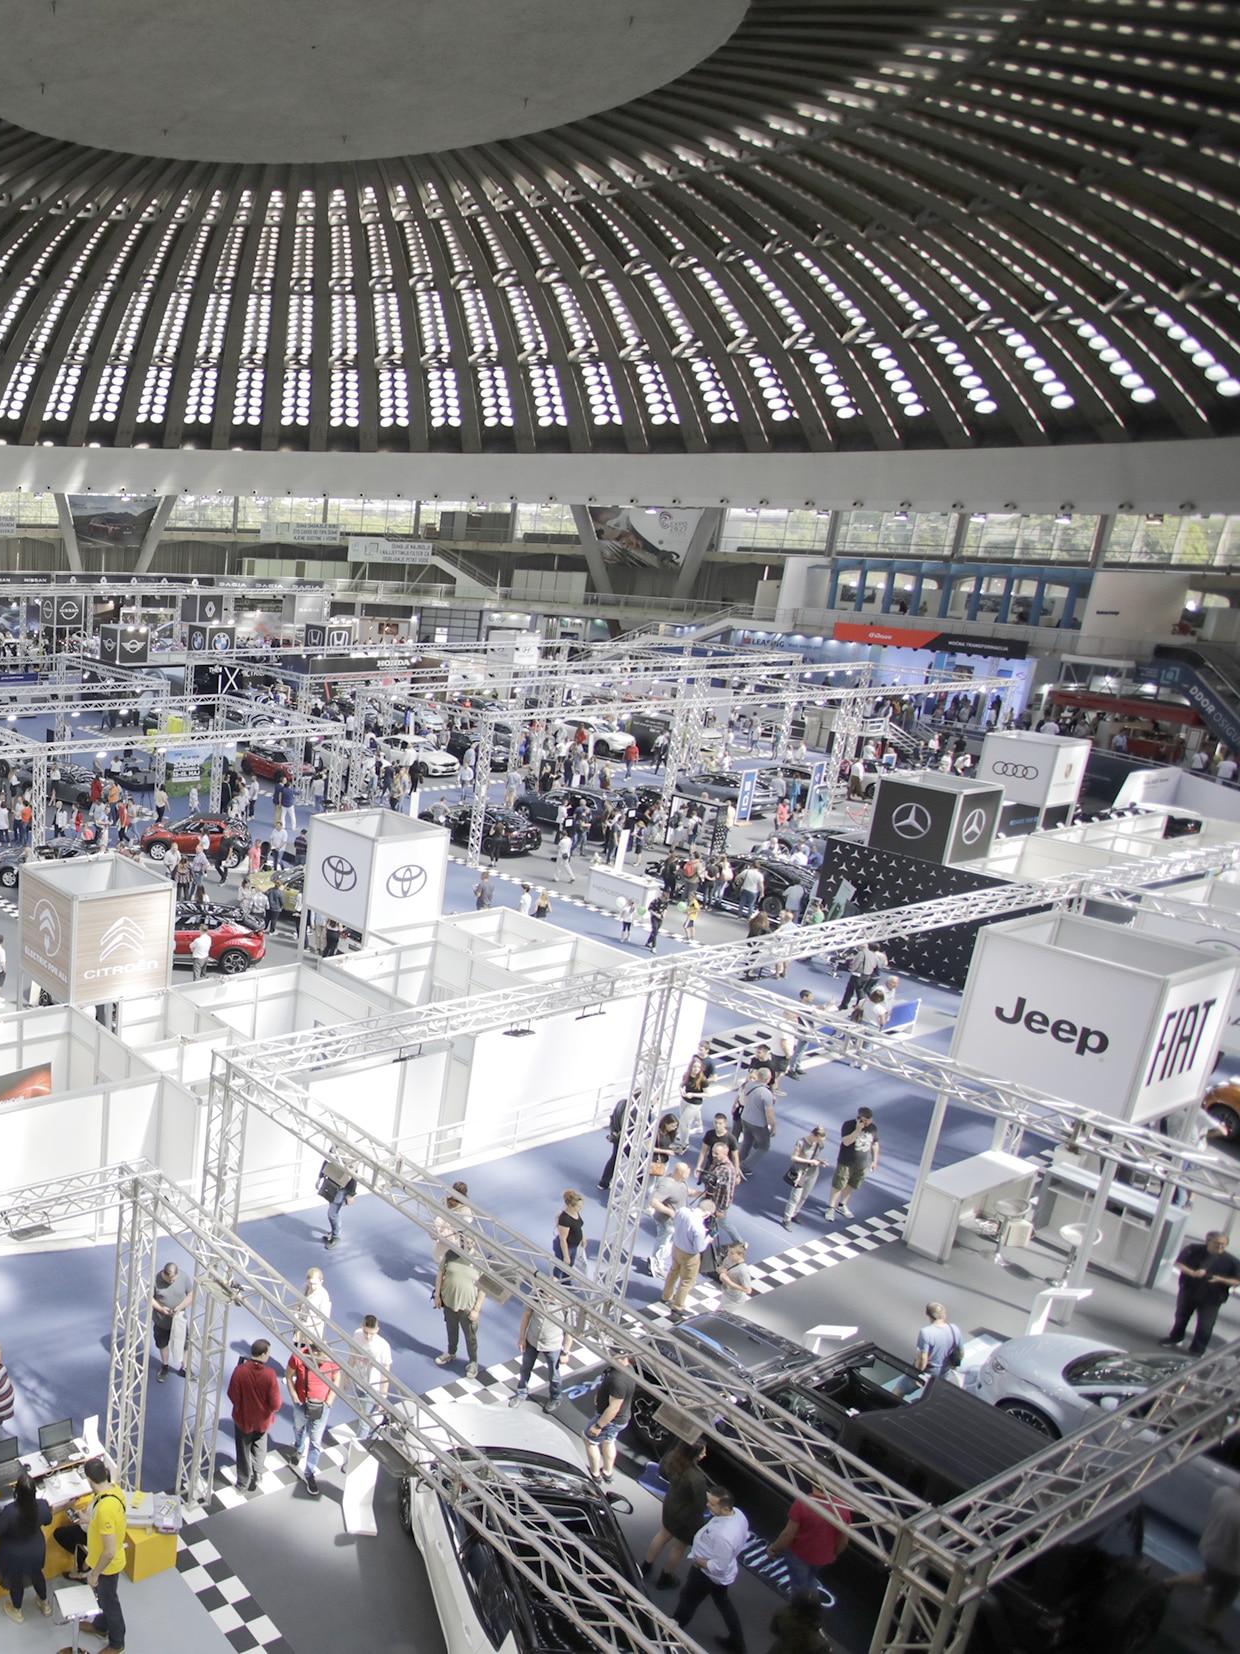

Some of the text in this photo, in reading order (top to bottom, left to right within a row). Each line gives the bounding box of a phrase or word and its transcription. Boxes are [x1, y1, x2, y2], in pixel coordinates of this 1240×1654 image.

[752, 637, 785, 648] LEASING
[966, 642, 1009, 651] TRANSFORMACIJA
[376, 659, 411, 667] HONDA
[1188, 685, 1240, 751] DDOR OSIGU
[24, 944, 68, 983] ELECTRIC FOR ALL
[994, 996, 1110, 1056] Jeep
[1144, 997, 1218, 1088] FIAT
